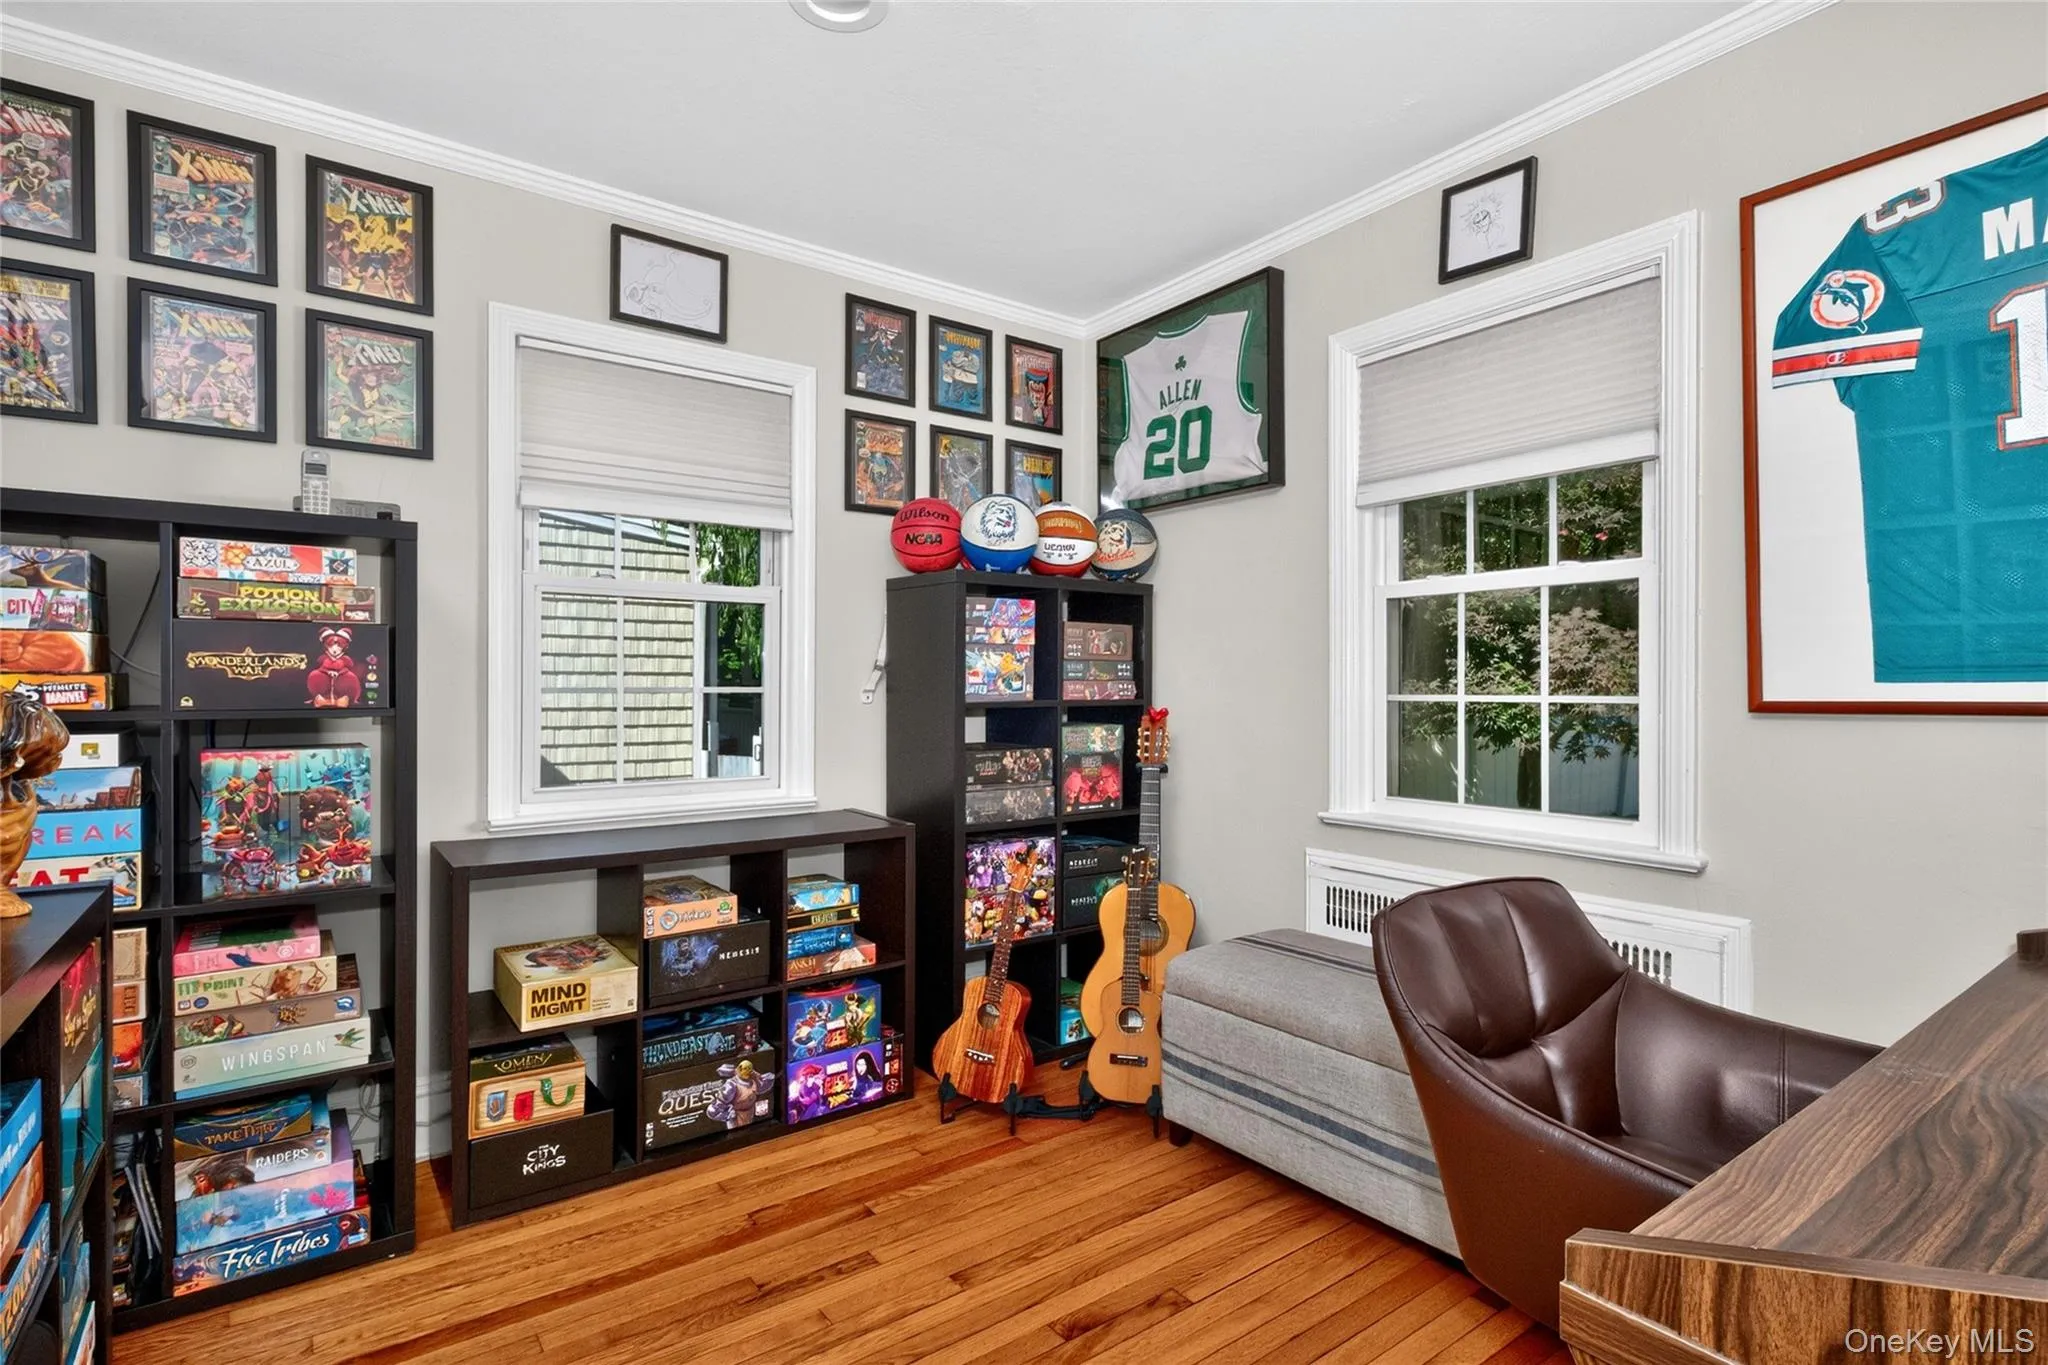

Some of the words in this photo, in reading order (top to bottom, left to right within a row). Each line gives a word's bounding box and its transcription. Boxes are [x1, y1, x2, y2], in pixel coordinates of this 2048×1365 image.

[168, 147, 254, 183] X-MEN
[1982, 197, 2048, 261] M
[1159, 379, 1202, 410] ALLEN
[1143, 405, 1213, 480] 20
[900, 507, 950, 522] Wilson
[905, 533, 943, 545] NCAA
[252, 557, 291, 570] AZUL
[239, 586, 320, 602] POTION
[218, 597, 341, 617] EXPLOSION
[234, 666, 264, 675] WAR
[45, 691, 87, 705] MARVEL
[719, 946, 760, 960] NEMESIS
[531, 982, 586, 1004] MIND
[531, 998, 587, 1019] MGMT
[221, 1039, 327, 1072] WINGSPAN
[501, 1053, 545, 1070] OMEN
[255, 1148, 309, 1168] RAIDERS
[527, 1144, 560, 1161] CITY
[523, 1155, 566, 1175] KINGS
